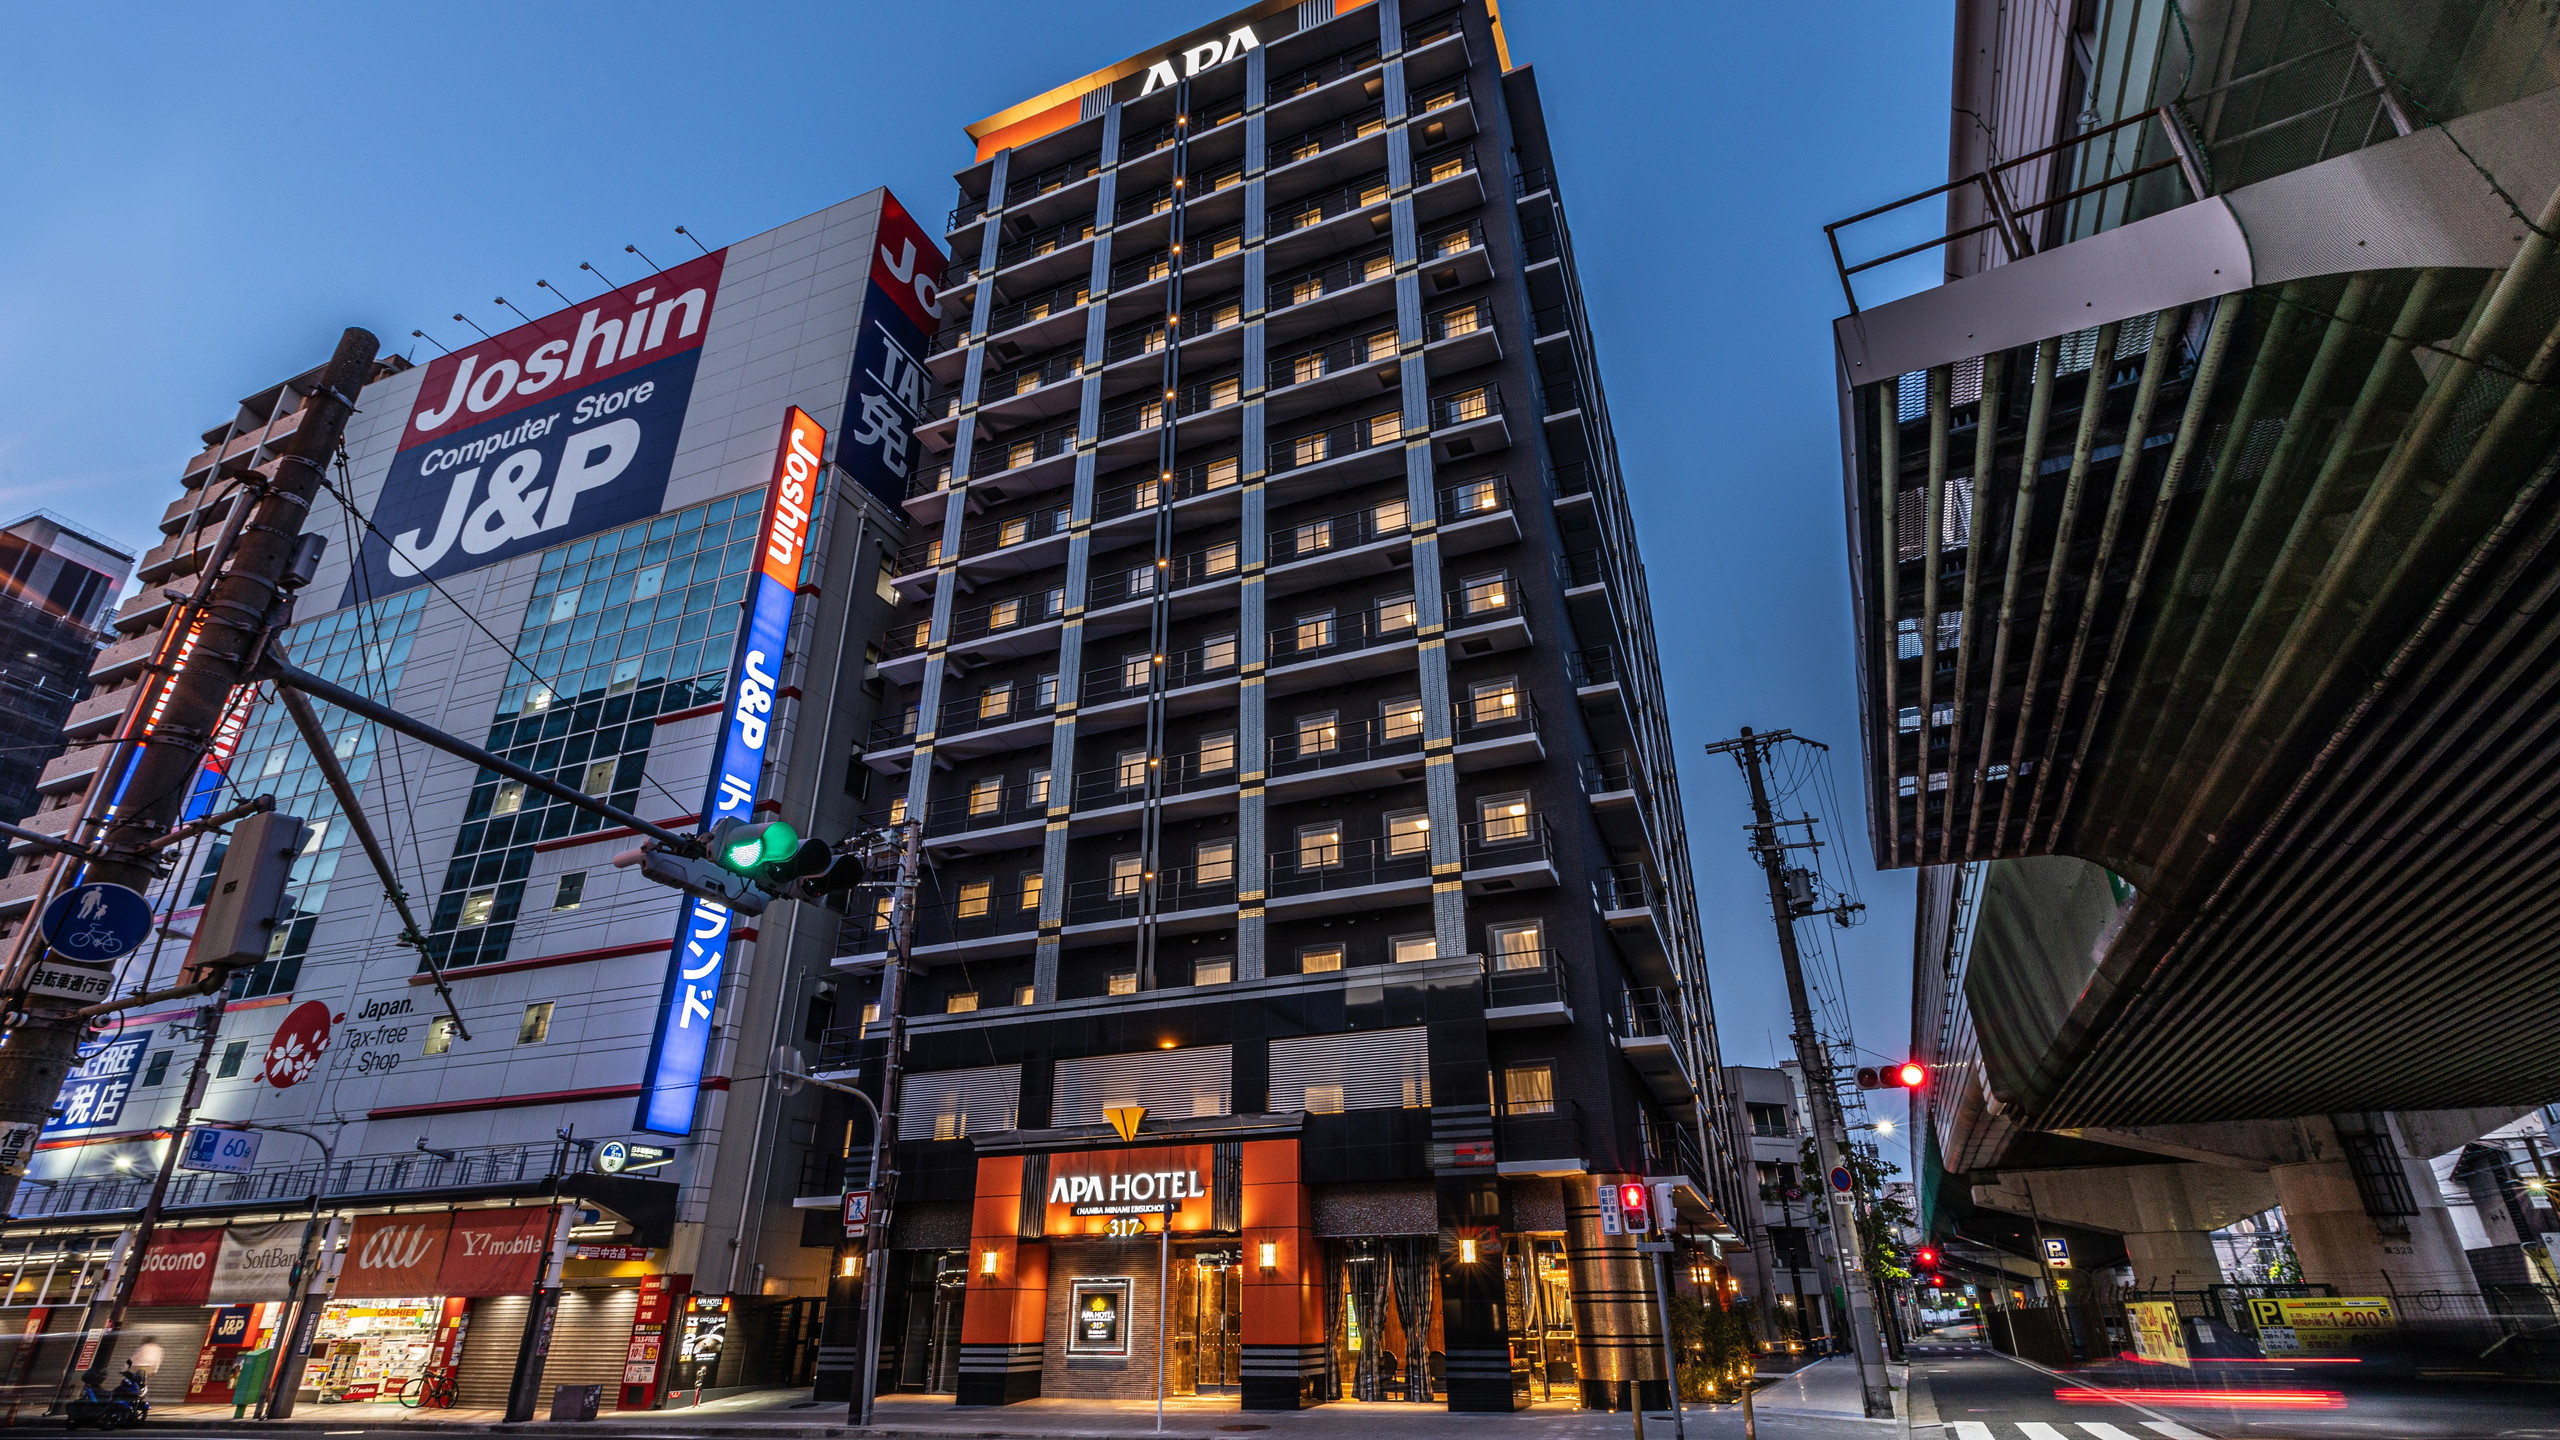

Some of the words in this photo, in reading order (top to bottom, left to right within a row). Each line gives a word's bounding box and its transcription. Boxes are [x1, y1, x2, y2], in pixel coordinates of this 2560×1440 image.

[1140, 25, 1260, 97] APA
[414, 286, 708, 433] Joshin
[420, 411, 560, 477] Computer
[572, 380, 656, 426] Store
[387, 417, 641, 579] J&P
[769, 428, 820, 567] Joshin
[738, 649, 777, 751] J&P
[31, 970, 112, 996] 自転車通行可
[358, 998, 414, 1021] Japan.
[345, 1024, 408, 1049] Tax-free
[357, 1050, 401, 1075] Shop
[200, 1133, 215, 1149] P
[223, 1138, 252, 1158] 60分
[1050, 1175, 1104, 1204] APA
[1110, 1170, 1205, 1201] HOTEL
[1104, 1205, 1130, 1215] MINAMI
[1108, 1218, 1140, 1237] 317
[243, 1247, 297, 1270] SoftBan
[359, 1224, 434, 1270] au
[600, 1247, 627, 1260] 中古品
[2046, 1241, 2062, 1257] P
[377, 1308, 418, 1317] CASHIER
[1094, 1311, 1115, 1319] HOTEL
[2259, 1302, 2278, 1325] P
[2327, 1312, 2380, 1328] 1,200
[218, 1319, 245, 1336] J&P
